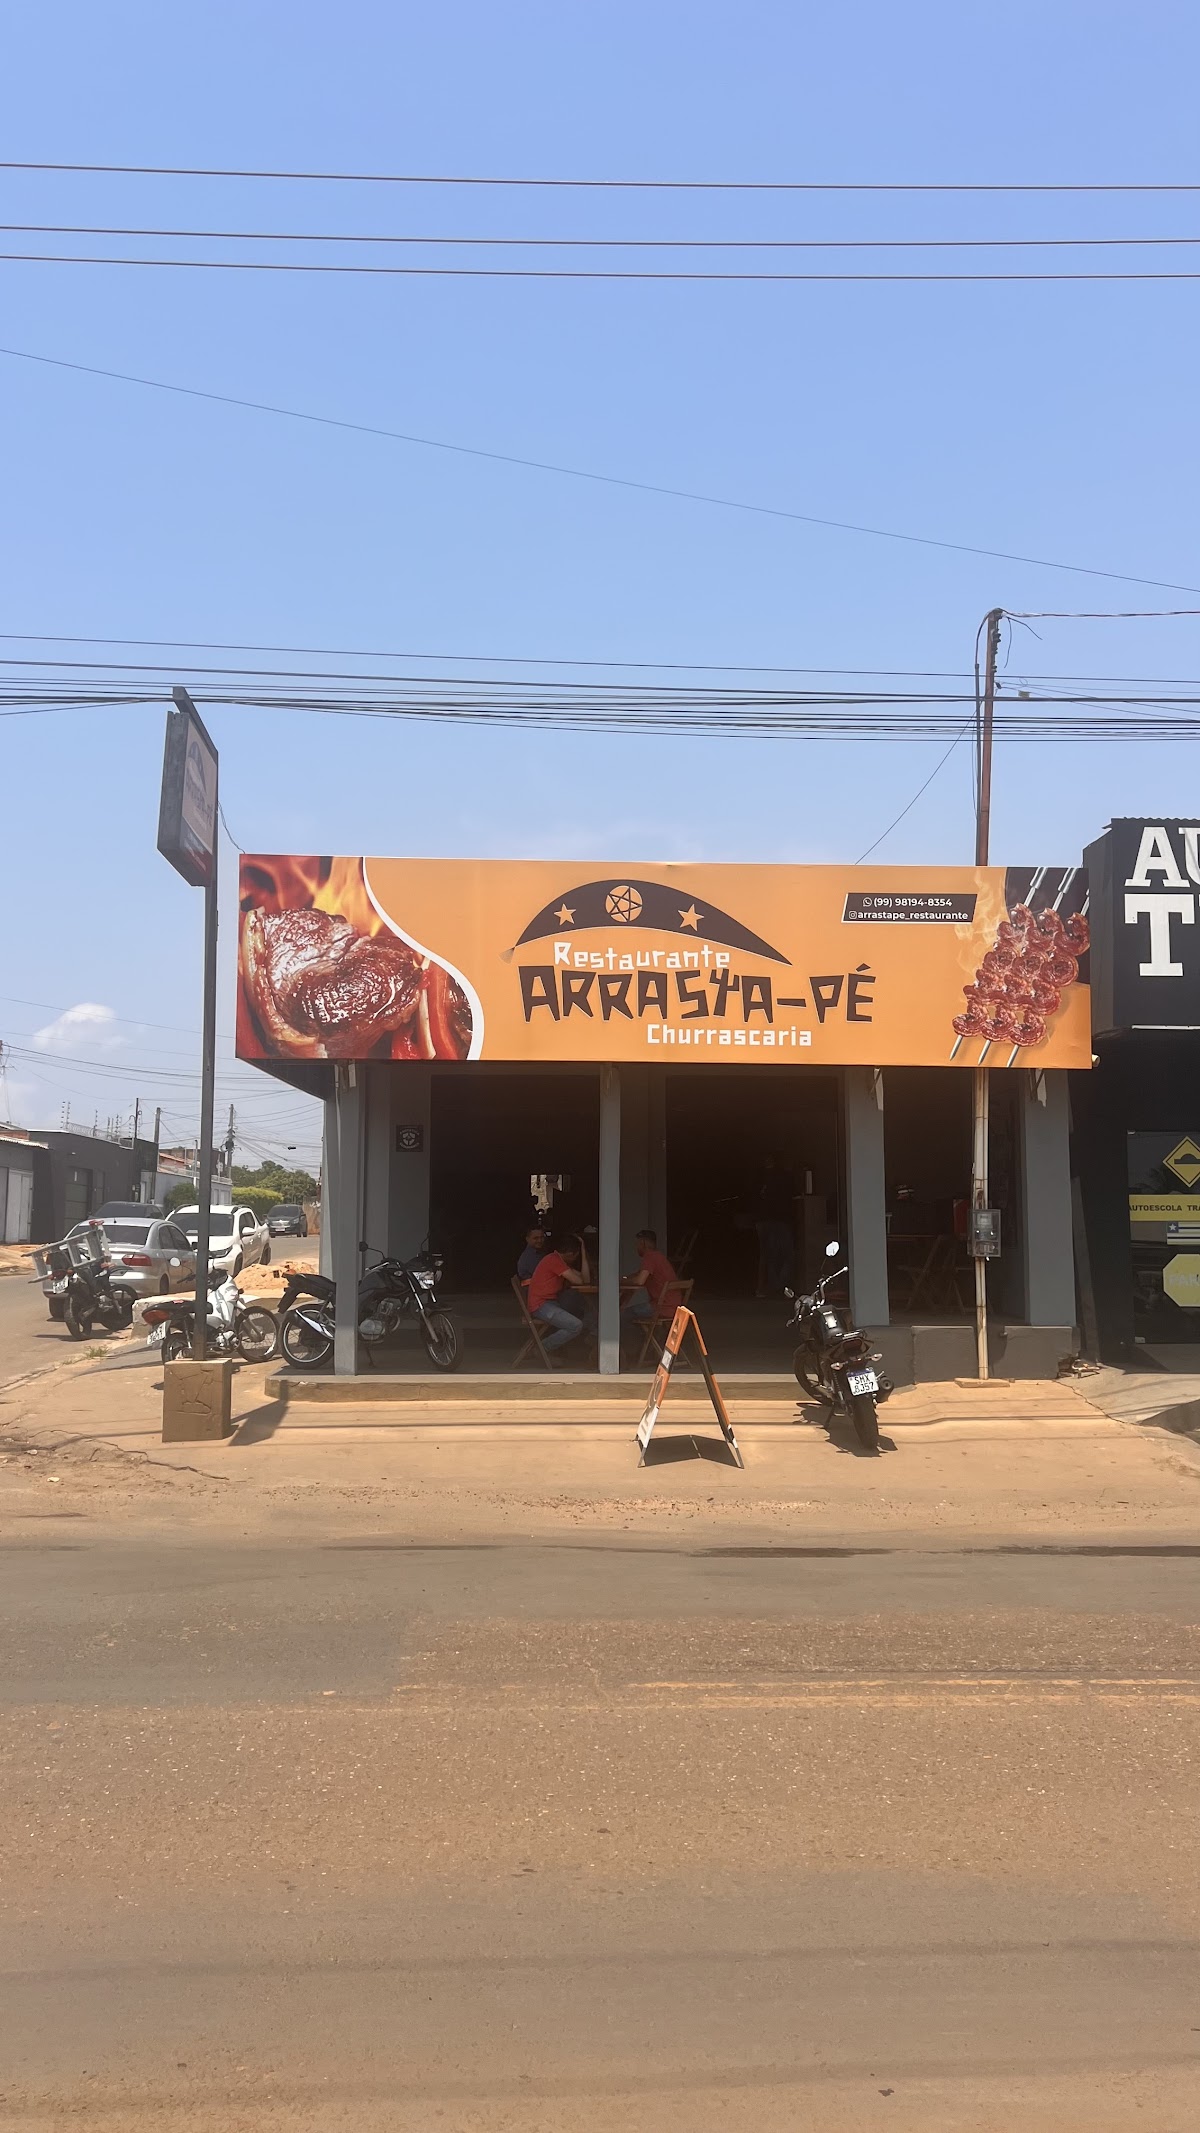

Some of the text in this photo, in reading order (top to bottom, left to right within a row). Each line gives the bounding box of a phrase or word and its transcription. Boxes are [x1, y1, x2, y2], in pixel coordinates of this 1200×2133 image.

[873, 897, 953, 907] (99) 98194-8354
[857, 911, 969, 921] arrastape_restaurante
[553, 941, 730, 971] Restaurante
[517, 963, 877, 1025] ARRASTA-PÉ
[646, 1023, 812, 1047] Churrascaria
[854, 1374, 870, 1384] SMX
